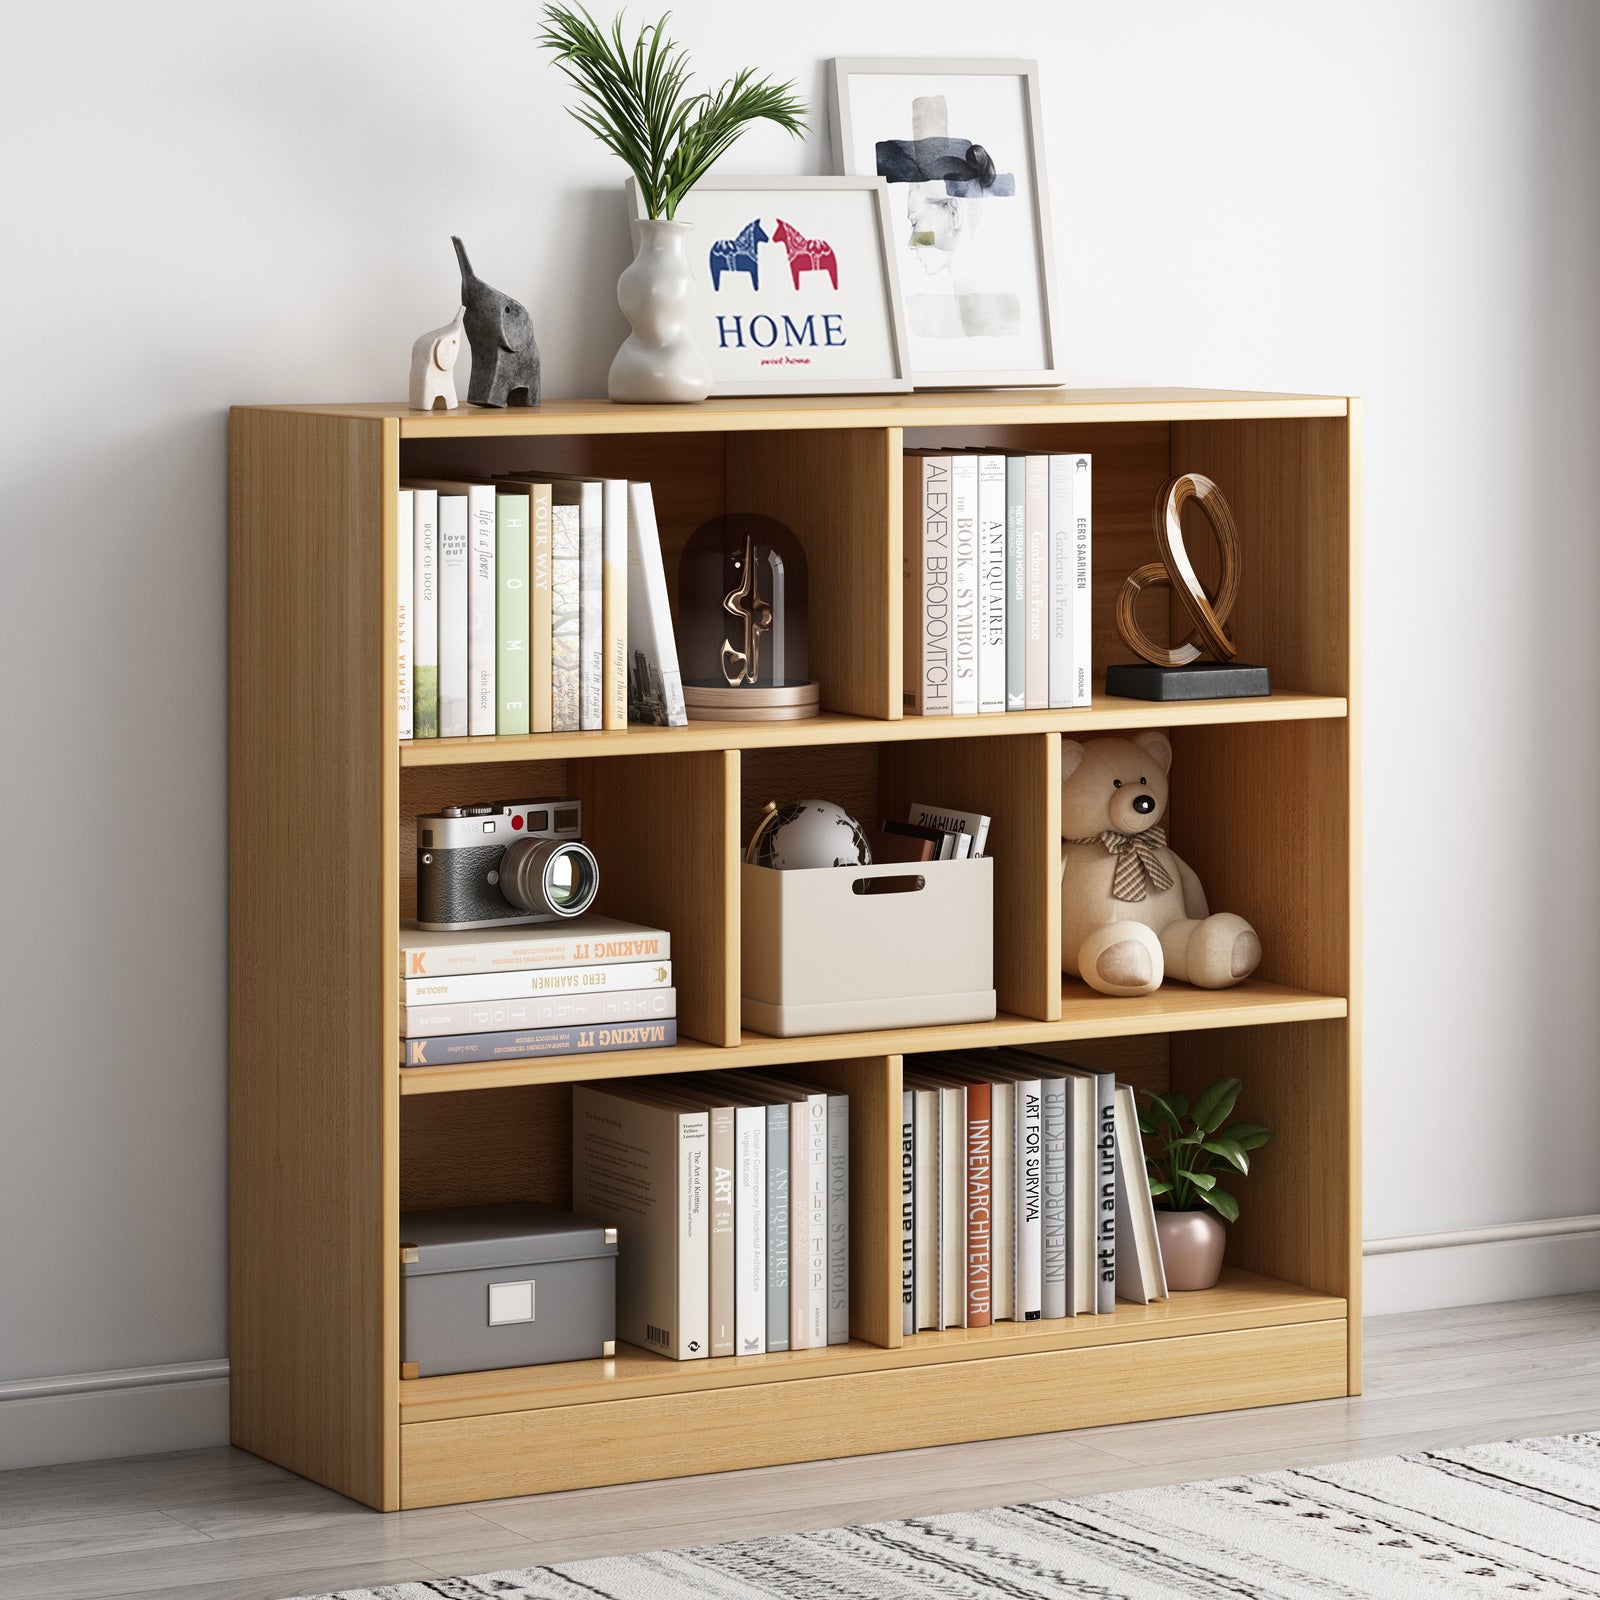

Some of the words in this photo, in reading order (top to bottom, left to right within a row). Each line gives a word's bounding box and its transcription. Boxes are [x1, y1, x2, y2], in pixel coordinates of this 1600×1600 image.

[716, 314, 847, 348] HOME
[786, 356, 811, 365] home
[478, 509, 492, 525] life
[926, 464, 948, 548] ALEXEY
[957, 496, 965, 512] THE
[1015, 505, 1023, 526] NEW
[535, 495, 548, 545] YOUR
[1077, 518, 1086, 540] EERO
[957, 518, 973, 567] BOOK
[1015, 528, 1023, 558] URBAN
[1030, 531, 1044, 580] Gardens
[1055, 531, 1068, 580] Gardens
[478, 549, 492, 579] flower
[535, 552, 548, 591] WAY
[957, 573, 965, 584] OF
[1077, 544, 1086, 589] SAARINEN
[987, 521, 1003, 646] ANTIQUAIRES
[1015, 560, 1024, 600] HOUSING
[1031, 584, 1043, 597] in
[1055, 583, 1067, 597] in
[506, 518, 522, 710] HOME
[926, 557, 948, 699] BRODOVITCH
[1031, 599, 1043, 640] France
[1055, 599, 1068, 639] France
[957, 588, 974, 679] SYMBOLS
[593, 651, 602, 670] love
[615, 638, 625, 677] stronger
[481, 671, 490, 687] chris
[593, 674, 601, 682] in
[616, 680, 626, 701] than
[481, 689, 490, 709] choice
[591, 686, 601, 719] prague
[616, 706, 625, 719] sin
[461, 823, 479, 833] M8
[412, 952, 425, 974] K
[573, 944, 590, 960] IT
[593, 939, 659, 958] MAKING
[416, 985, 448, 996] ASSOULINE
[531, 974, 579, 989] SAARINEN
[583, 973, 606, 986] EERO
[473, 1006, 526, 1023] Top
[541, 1005, 586, 1019] the
[606, 996, 666, 1013] Over
[418, 1016, 452, 1025] ASSOULINE
[599, 1026, 665, 1044] MAKING
[413, 1041, 427, 1063] K
[578, 1031, 594, 1047] IT
[1026, 1094, 1039, 1121] ART
[742, 1130, 751, 1156] Virginia
[752, 1129, 760, 1150] Detail
[812, 1104, 823, 1162] Over
[831, 1135, 839, 1151] THE
[1026, 1126, 1039, 1155] FOR
[1098, 1105, 1115, 1175] urban
[714, 1167, 731, 1205] ART
[743, 1158, 751, 1186] McLeod
[751, 1159, 761, 1208] Contemporary
[831, 1155, 846, 1204] BOOK
[693, 1186, 701, 1213] Knitting
[812, 1181, 823, 1223] the
[1025, 1159, 1040, 1223] SURVIVAL
[1045, 1092, 1065, 1284] INNENARCHITEKTUR
[1102, 1182, 1115, 1216] an
[774, 1167, 788, 1288] ANTIQUAIRES
[831, 1209, 839, 1218] OF
[903, 1202, 912, 1231] an
[969, 1119, 989, 1314] INNENARCHITEKTUR
[753, 1210, 761, 1248] Residential
[796, 1201, 806, 1264] BORDEAUX
[1098, 1218, 1115, 1244] in
[753, 1250, 761, 1292] Architecture
[812, 1238, 823, 1287] Top
[831, 1224, 846, 1310] SYMBOLS
[1099, 1249, 1115, 1282] art
